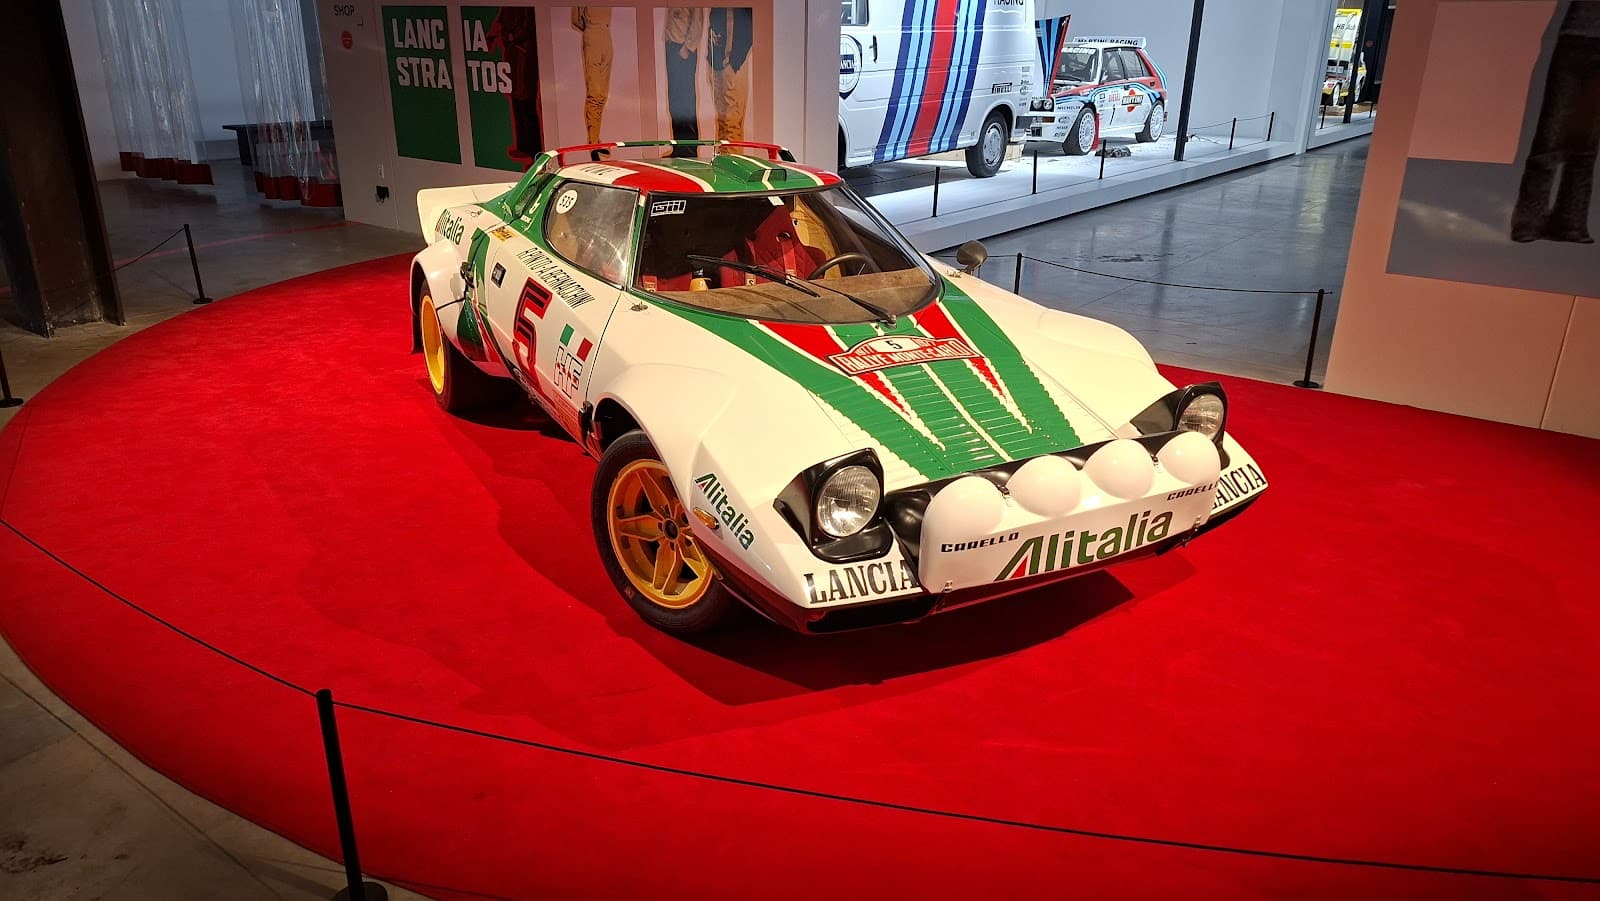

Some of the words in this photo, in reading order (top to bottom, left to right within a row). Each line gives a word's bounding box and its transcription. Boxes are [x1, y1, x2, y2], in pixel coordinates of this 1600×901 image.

[334, 4, 355, 16] SHOP
[391, 18, 445, 50] LANC
[464, 20, 489, 52] IA
[396, 57, 453, 90] STRA
[467, 60, 513, 94] TOS
[434, 208, 465, 246] Alitalia
[512, 276, 553, 388] 5
[885, 339, 904, 350] 5
[837, 349, 892, 374] RALLYE
[888, 339, 973, 363] MONTE-CARLO
[1166, 480, 1219, 501] CARELL
[1211, 463, 1267, 510] ANCIA
[694, 472, 756, 551] Alitalia
[940, 531, 1019, 553] CARELLO
[994, 510, 1174, 582] Alitalia
[804, 559, 921, 604] LANCIA
